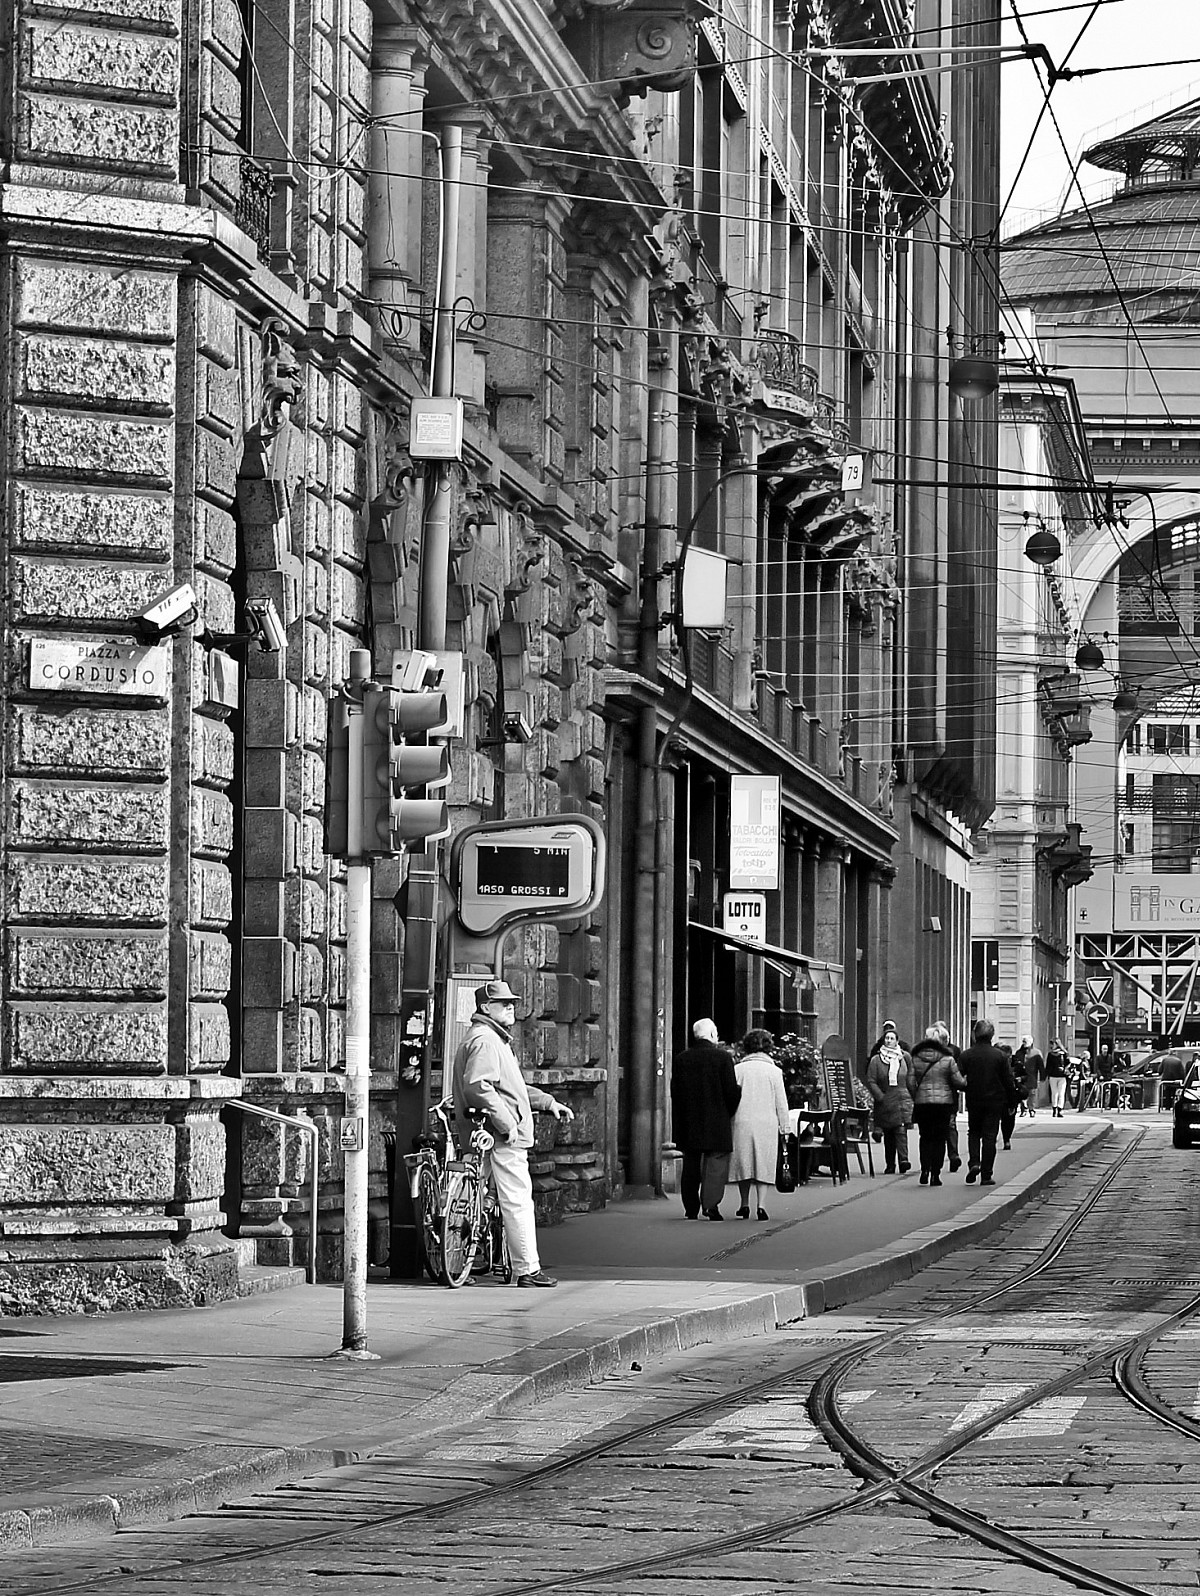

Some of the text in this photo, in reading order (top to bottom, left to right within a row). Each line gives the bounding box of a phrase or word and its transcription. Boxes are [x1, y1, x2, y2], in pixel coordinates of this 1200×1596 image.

[848, 466, 858, 481] 79
[78, 647, 120, 659] PIAZZA
[42, 664, 155, 685] CORDUSIO
[734, 777, 777, 825] T
[732, 825, 777, 836] TABACCHI
[511, 885, 551, 895] GROSSI
[558, 887, 565, 896] P
[1164, 899, 1175, 907] IN
[728, 902, 761, 918] LOTTO
